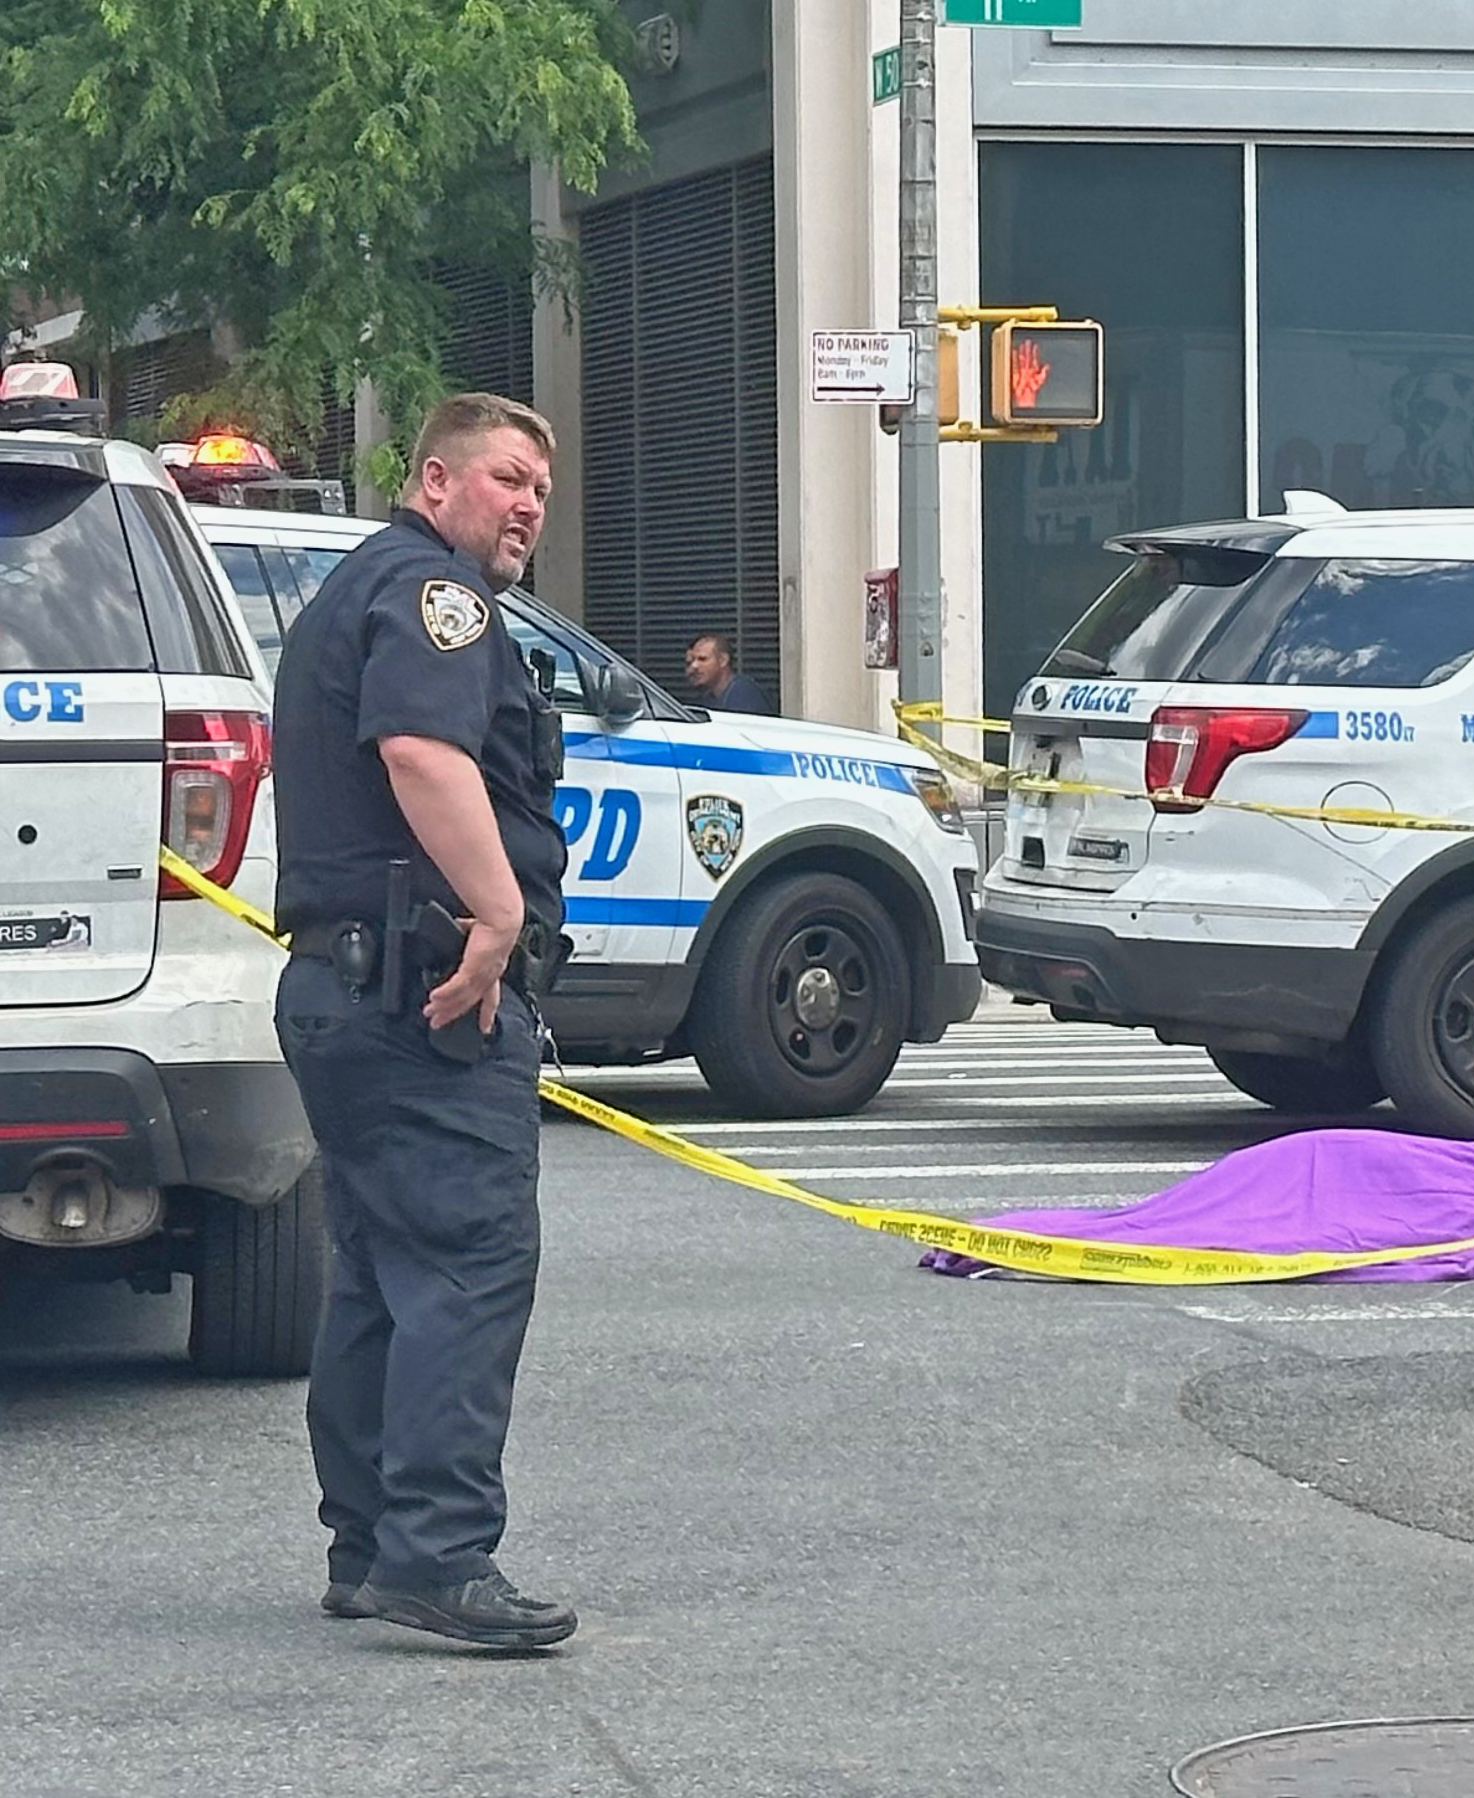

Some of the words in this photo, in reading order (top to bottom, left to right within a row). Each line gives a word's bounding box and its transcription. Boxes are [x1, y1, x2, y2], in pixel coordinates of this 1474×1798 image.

[817, 338, 834, 351] NO
[838, 338, 890, 351] PARKING
[4, 681, 84, 722] CE
[1060, 685, 1139, 713] POLICE
[1346, 711, 1402, 741] 3580
[795, 754, 876, 786] POLICE
